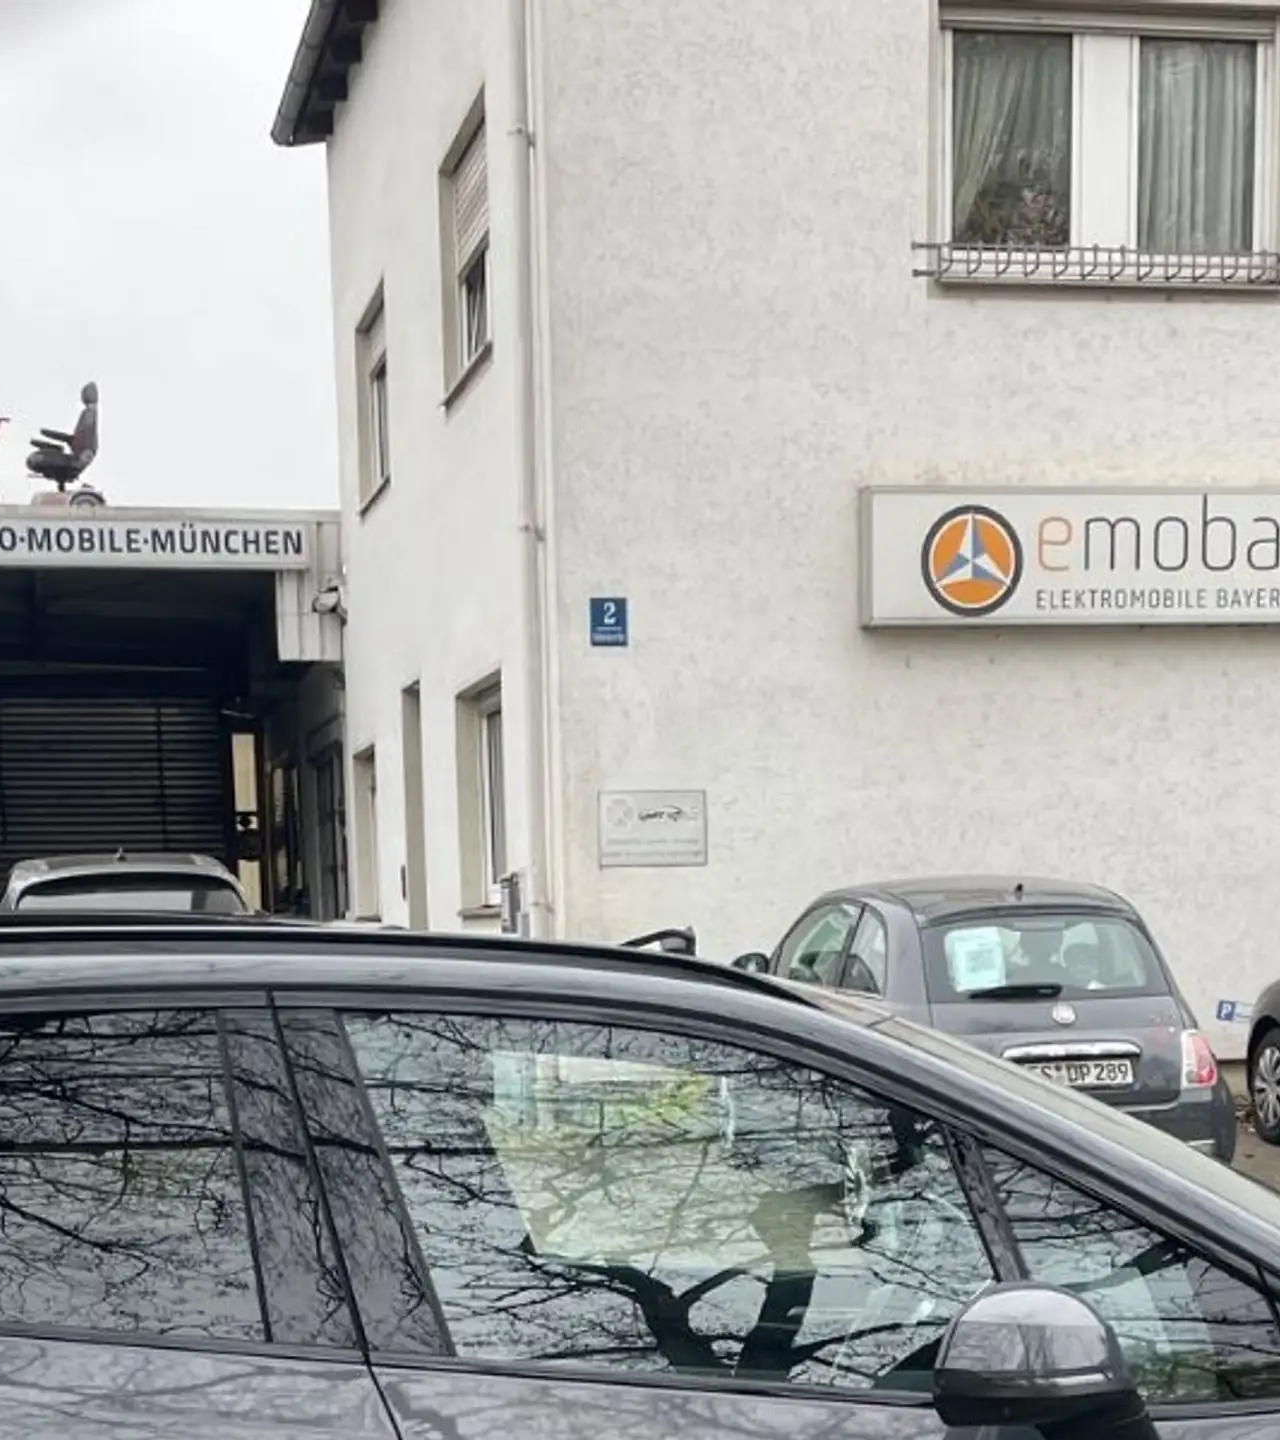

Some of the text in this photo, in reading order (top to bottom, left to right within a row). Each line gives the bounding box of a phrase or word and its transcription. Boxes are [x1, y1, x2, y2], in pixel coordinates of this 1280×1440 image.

[1036, 588, 1207, 609] ELEKTROMOBILE
[603, 602, 617, 625] 2
[1093, 1062, 1129, 1081] 289
